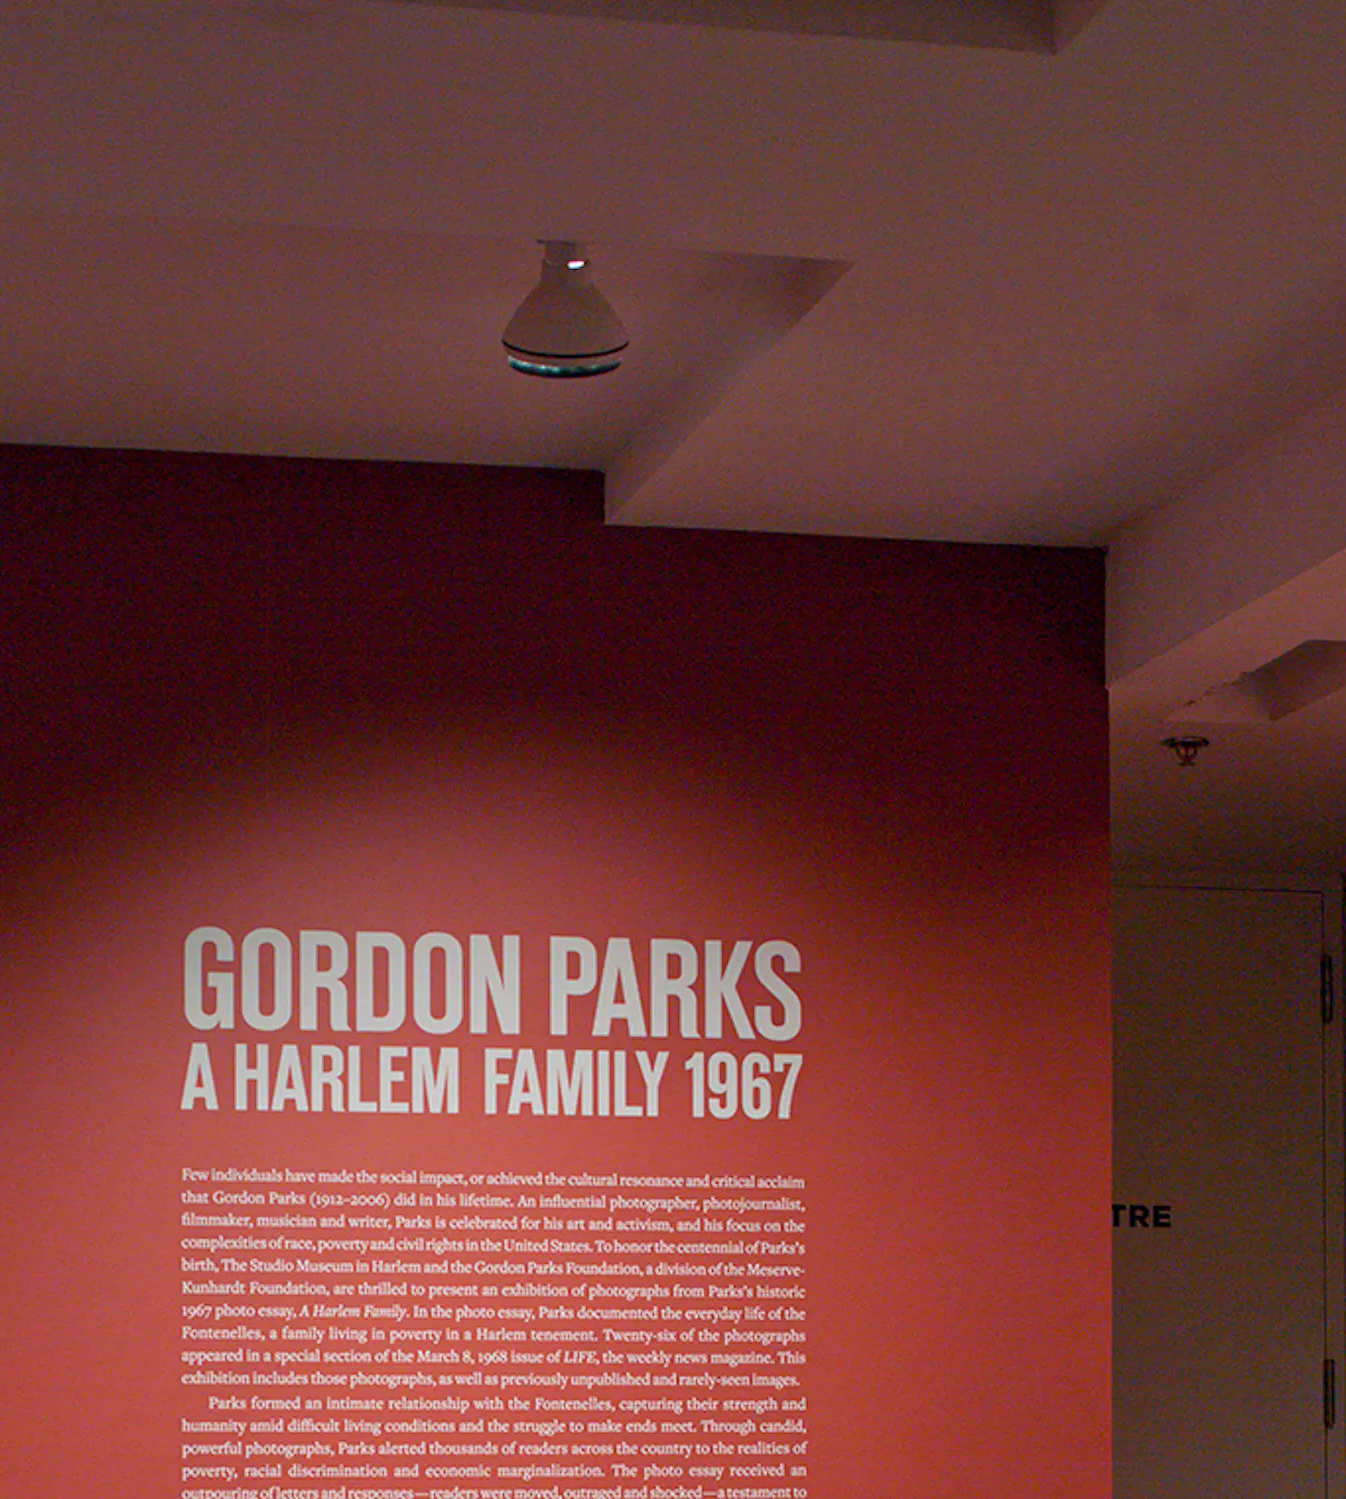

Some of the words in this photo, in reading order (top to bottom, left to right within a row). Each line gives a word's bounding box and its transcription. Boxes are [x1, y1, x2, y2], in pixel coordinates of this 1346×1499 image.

[185, 927, 520, 1034] GORDON
[550, 936, 800, 1040] PARKS
[181, 1043, 218, 1110] A
[235, 1044, 459, 1114] HARLEM
[485, 1048, 669, 1117] FAMILY
[685, 1052, 802, 1119] 1967
[181, 1190, 209, 1204] that
[213, 1190, 265, 1204] Gordon
[269, 1191, 306, 1204] Parks
[394, 1192, 416, 1206] did
[420, 1194, 433, 1206] in
[436, 1193, 456, 1206] his
[459, 1193, 514, 1208] lifetime.
[517, 1195, 536, 1208] An
[540, 1194, 606, 1208] influential
[610, 1195, 700, 1213] photographer,
[703, 1196, 806, 1214] photojournalist,
[181, 1212, 253, 1228] filmmaker,
[257, 1214, 317, 1227] musician
[320, 1214, 345, 1228] and
[348, 1215, 392, 1230] writer,
[395, 1215, 432, 1229] Parks
[435, 1216, 446, 1229] is
[449, 1215, 518, 1230] celebrated
[521, 1216, 541, 1230] for
[543, 1217, 563, 1230] his
[567, 1219, 585, 1230] art
[588, 1217, 613, 1231] and
[616, 1218, 674, 1233] activism,
[677, 1218, 701, 1232] and
[703, 1218, 723, 1232] his
[726, 1218, 761, 1232] focus
[764, 1222, 781, 1232] on
[784, 1219, 806, 1233] the
[1112, 1204, 1171, 1227] TRE
[182, 1326, 265, 1341] Fontenelles,
[269, 1330, 277, 1340] a
[282, 1325, 325, 1344] family
[329, 1326, 367, 1344] living
[372, 1327, 385, 1340] in
[390, 1329, 442, 1344] poverty
[446, 1328, 460, 1340] in
[464, 1331, 472, 1340] a
[476, 1327, 527, 1341] Harlem
[531, 1330, 598, 1342] tenement.
[680, 1328, 696, 1342] of
[698, 1328, 720, 1342] the
[724, 1328, 806, 1346] photographs
[209, 1396, 247, 1409] Parks
[251, 1396, 301, 1410] formed
[305, 1400, 322, 1410] an
[327, 1396, 384, 1410] intimate
[388, 1396, 470, 1414] relationship
[473, 1396, 504, 1410] with
[508, 1396, 530, 1411] the
[535, 1396, 616, 1412] Fontenelles,
[619, 1397, 683, 1415] capturing
[687, 1397, 719, 1411] their
[723, 1397, 778, 1414] strength
[782, 1397, 807, 1411] and
[181, 1418, 247, 1436] humanity
[250, 1418, 284, 1432] amid
[287, 1418, 340, 1432] difficult
[344, 1419, 381, 1436] living
[384, 1419, 455, 1433] conditions
[459, 1419, 484, 1432] and
[488, 1419, 509, 1432] the
[513, 1419, 566, 1436] struggle
[569, 1422, 584, 1432] to
[587, 1419, 622, 1432] make
[626, 1419, 657, 1433] ends
[661, 1422, 697, 1433] meet.
[700, 1419, 756, 1436] Through
[760, 1419, 807, 1433] candid,
[182, 1467, 238, 1481] poverty,
[244, 1464, 282, 1478] racial
[288, 1463, 388, 1477] discrimination
[394, 1464, 419, 1477] and
[425, 1464, 491, 1478] economic
[497, 1463, 605, 1481] marginalization.
[611, 1463, 638, 1477] The
[644, 1463, 683, 1480] photo
[689, 1467, 724, 1480] essay
[730, 1463, 785, 1477] received
[790, 1466, 807, 1476] an
